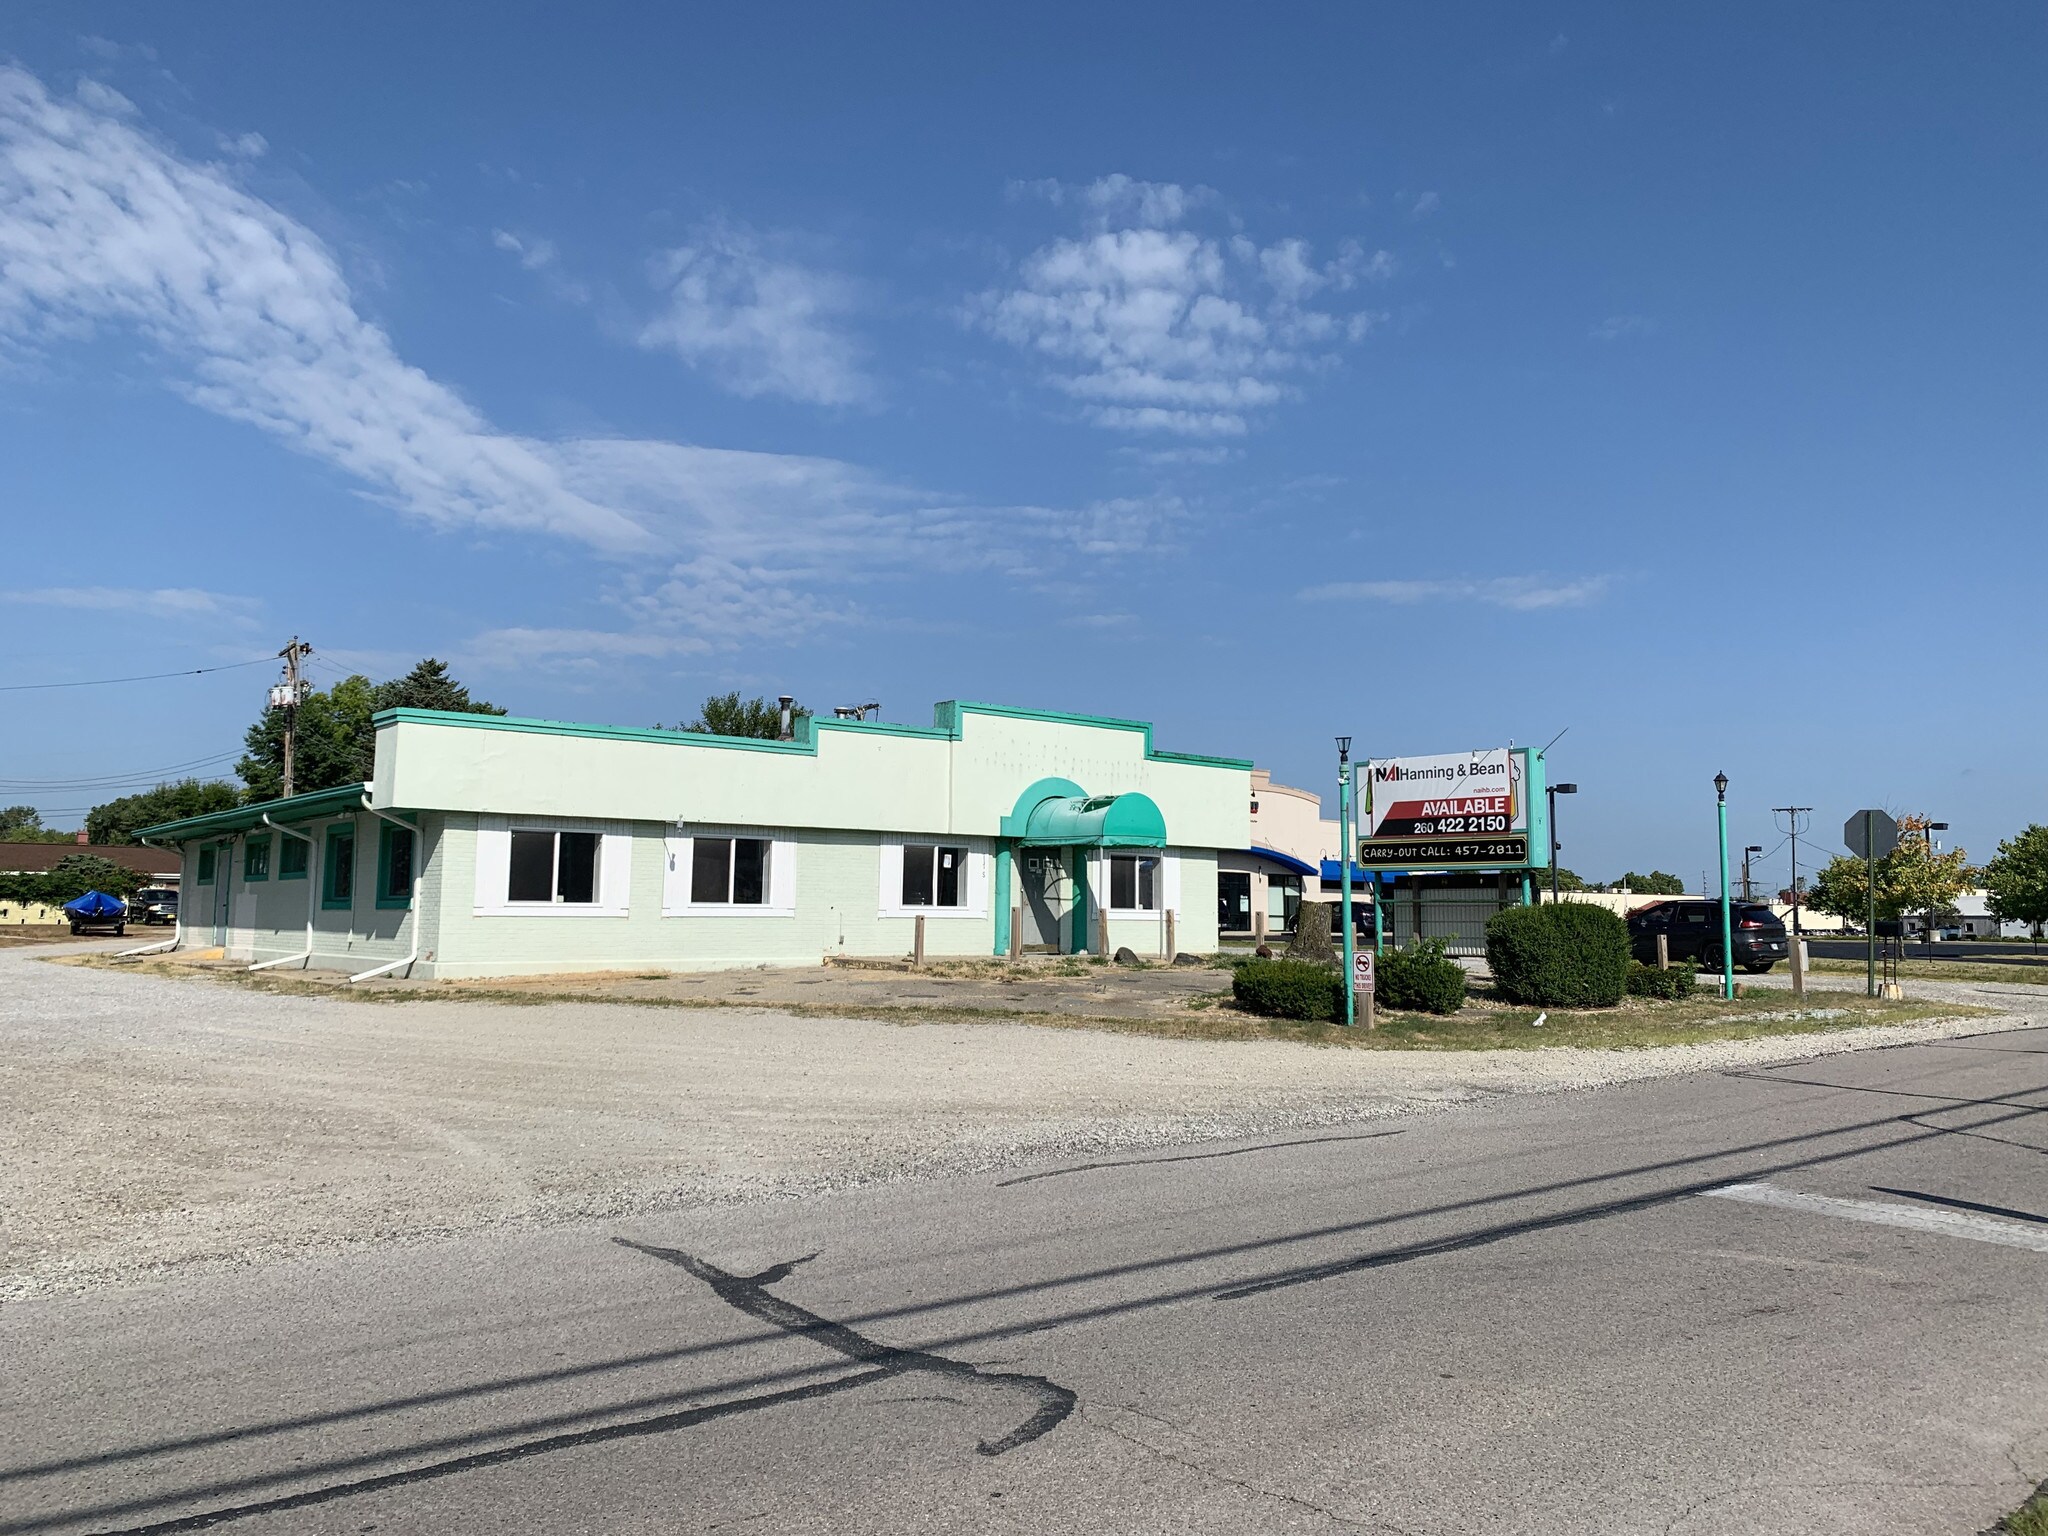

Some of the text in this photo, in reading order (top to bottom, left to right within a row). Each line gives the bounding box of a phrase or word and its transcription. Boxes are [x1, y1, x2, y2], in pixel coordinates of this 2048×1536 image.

[1376, 763, 1505, 782] NAI Hanning & Bean
[1422, 797, 1505, 816] AVAILABLE
[1414, 816, 1505, 834] 260 422 2150
[1364, 845, 1524, 858] CARRY-OUT CALL: 457-2811
